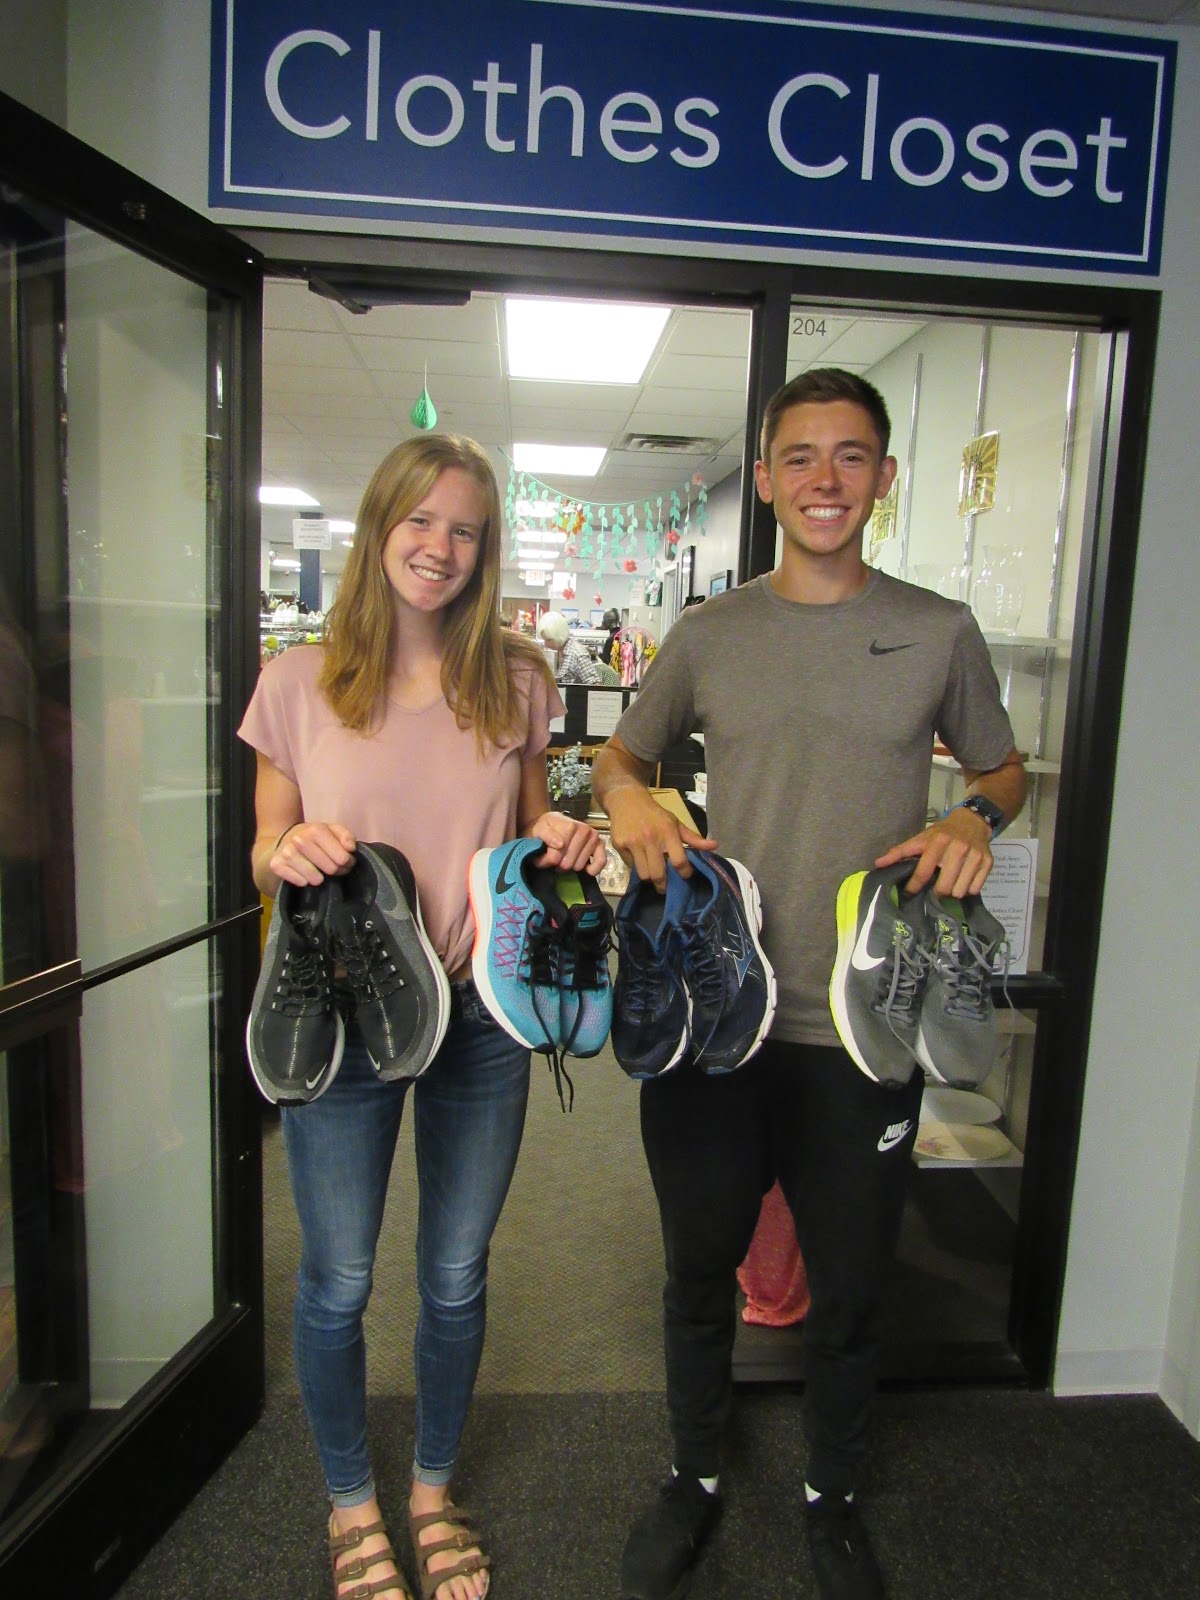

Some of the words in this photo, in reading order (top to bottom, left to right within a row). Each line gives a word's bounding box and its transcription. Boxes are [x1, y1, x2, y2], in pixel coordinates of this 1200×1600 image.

[264, 29, 720, 169] Clothes
[768, 72, 1127, 204] Closet
[792, 318, 827, 336] 204
